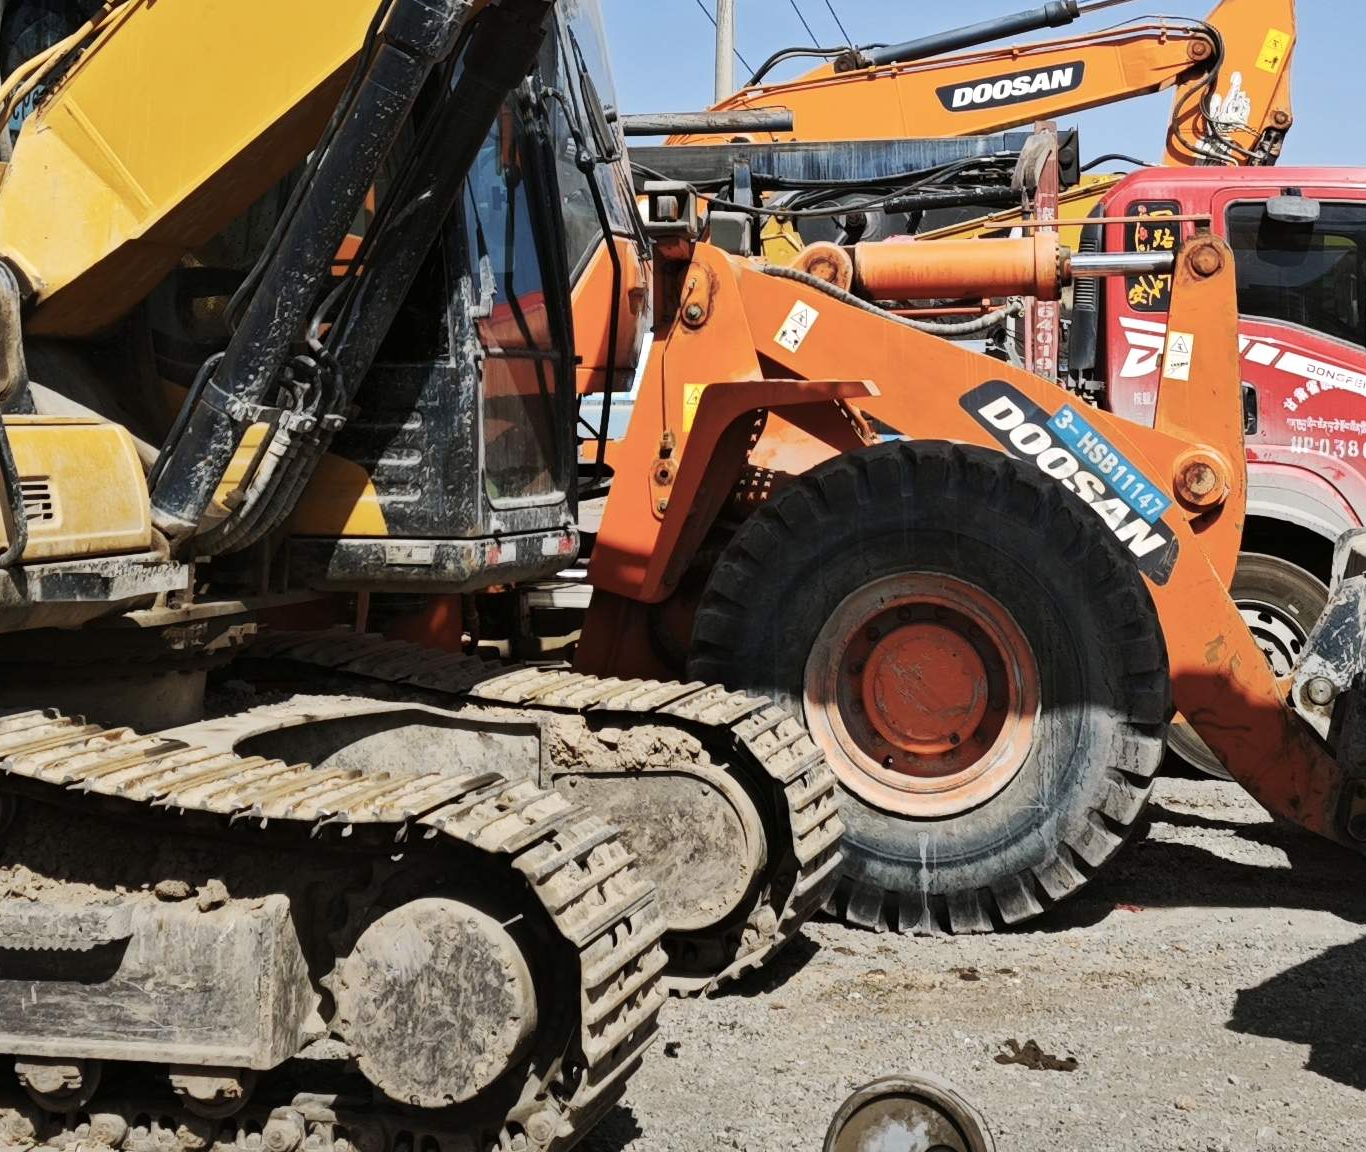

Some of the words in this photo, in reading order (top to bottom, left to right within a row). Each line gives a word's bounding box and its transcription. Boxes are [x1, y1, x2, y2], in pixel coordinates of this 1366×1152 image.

[951, 67, 1074, 108] DOOSAN
[977, 395, 1167, 558] DOOSAN
[1076, 430, 1165, 516] HSB11147
